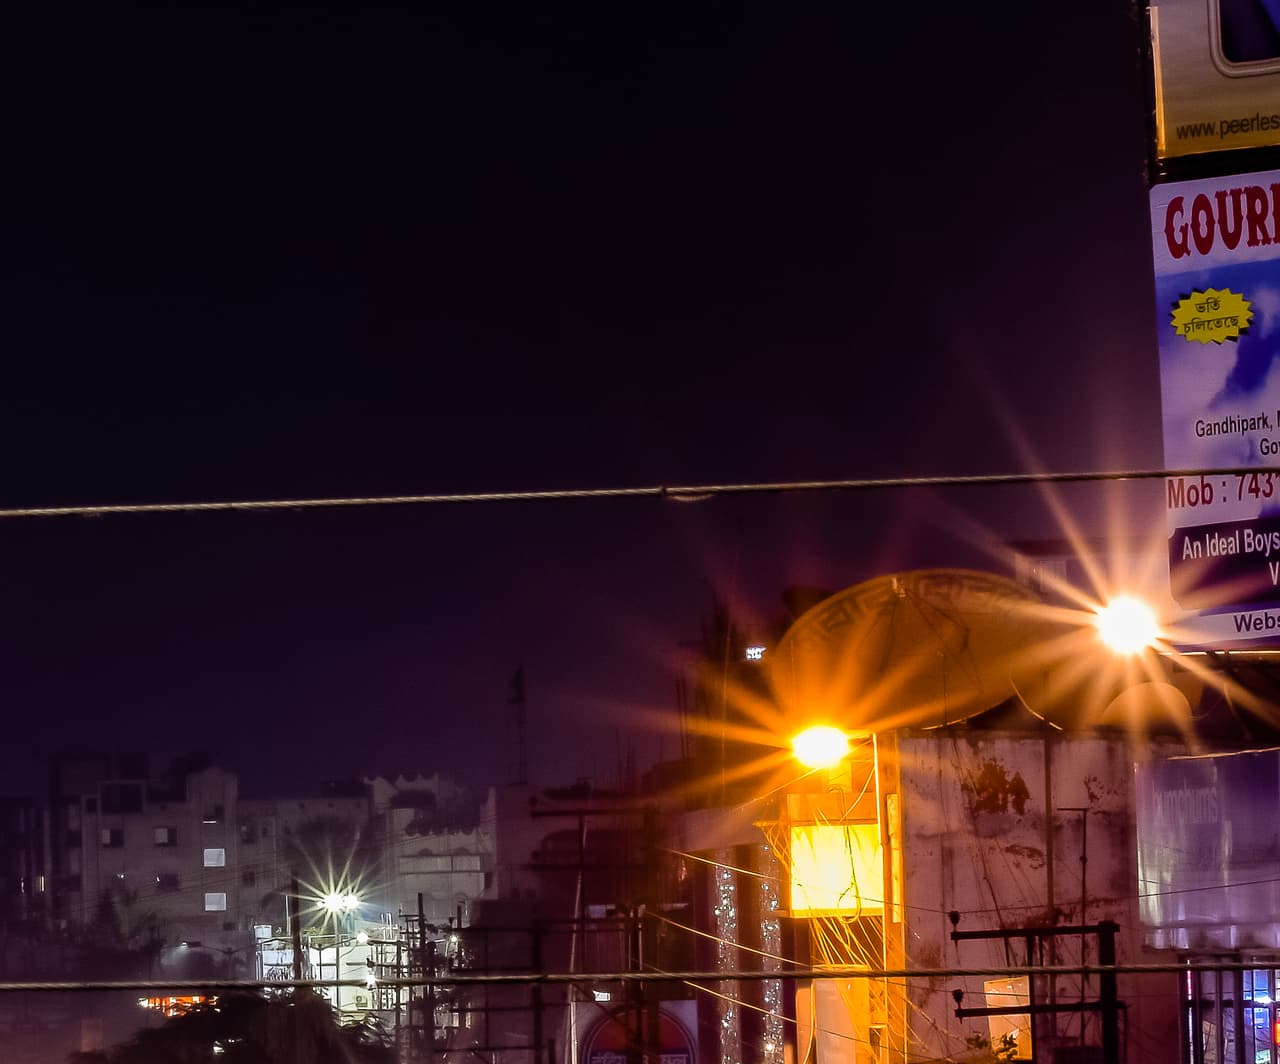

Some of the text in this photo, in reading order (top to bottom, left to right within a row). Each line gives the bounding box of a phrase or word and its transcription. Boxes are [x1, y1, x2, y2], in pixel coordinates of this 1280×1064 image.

[1195, 412, 1273, 439] Gandhipark,
[1259, 438, 1280, 456] Go
[1168, 475, 1213, 509] Mob
[1182, 526, 1280, 560] An Ideal Boys
